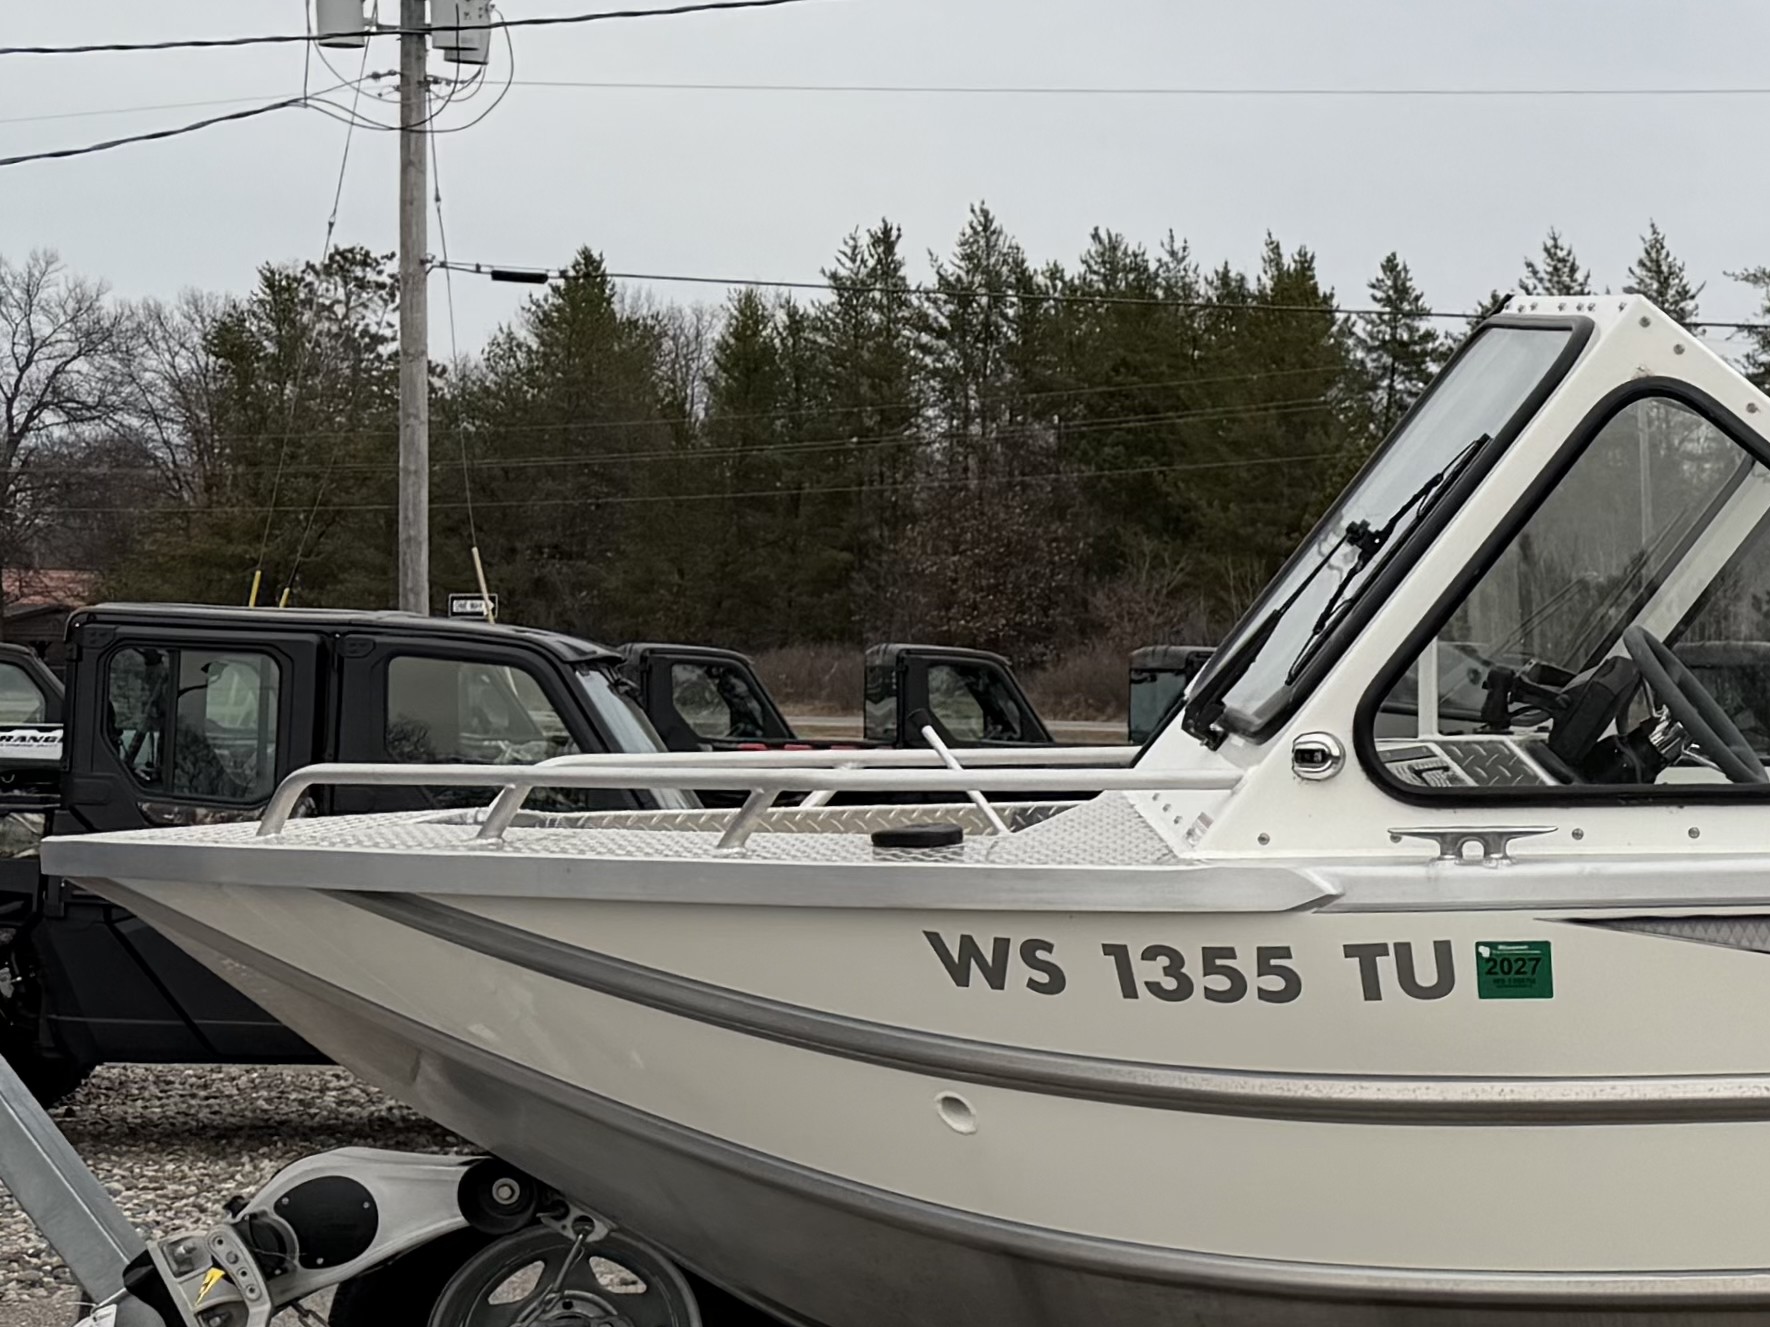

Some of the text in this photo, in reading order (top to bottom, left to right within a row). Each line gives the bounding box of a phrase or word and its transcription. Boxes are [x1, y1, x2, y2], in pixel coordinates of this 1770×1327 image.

[922, 929, 1456, 1005] WS 1355 TU
[1484, 957, 1543, 976] 2027
